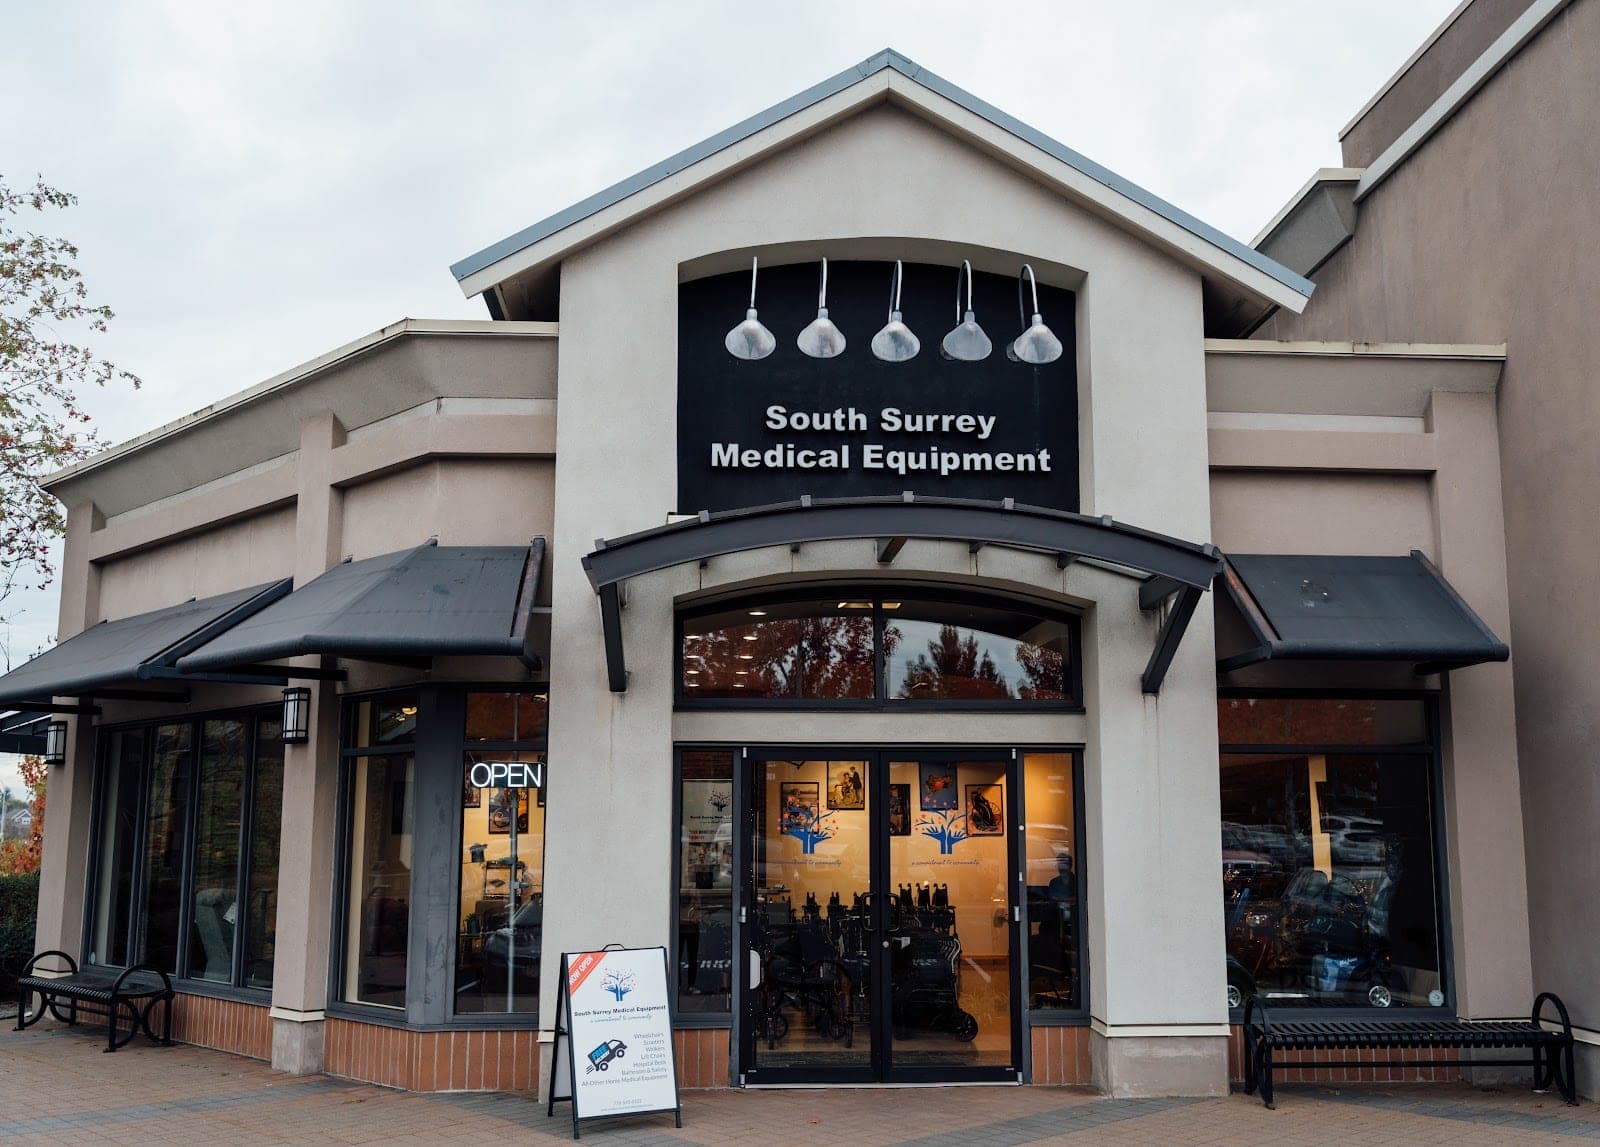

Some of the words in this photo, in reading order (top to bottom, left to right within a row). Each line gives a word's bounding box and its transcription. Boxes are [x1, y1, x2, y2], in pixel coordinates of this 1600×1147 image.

[766, 405, 867, 431] South
[880, 408, 996, 439] Surrey
[711, 443, 849, 468] Medical
[863, 445, 1051, 475] Equipment
[470, 763, 541, 787] OPEN
[636, 1003, 666, 1012] Equipment
